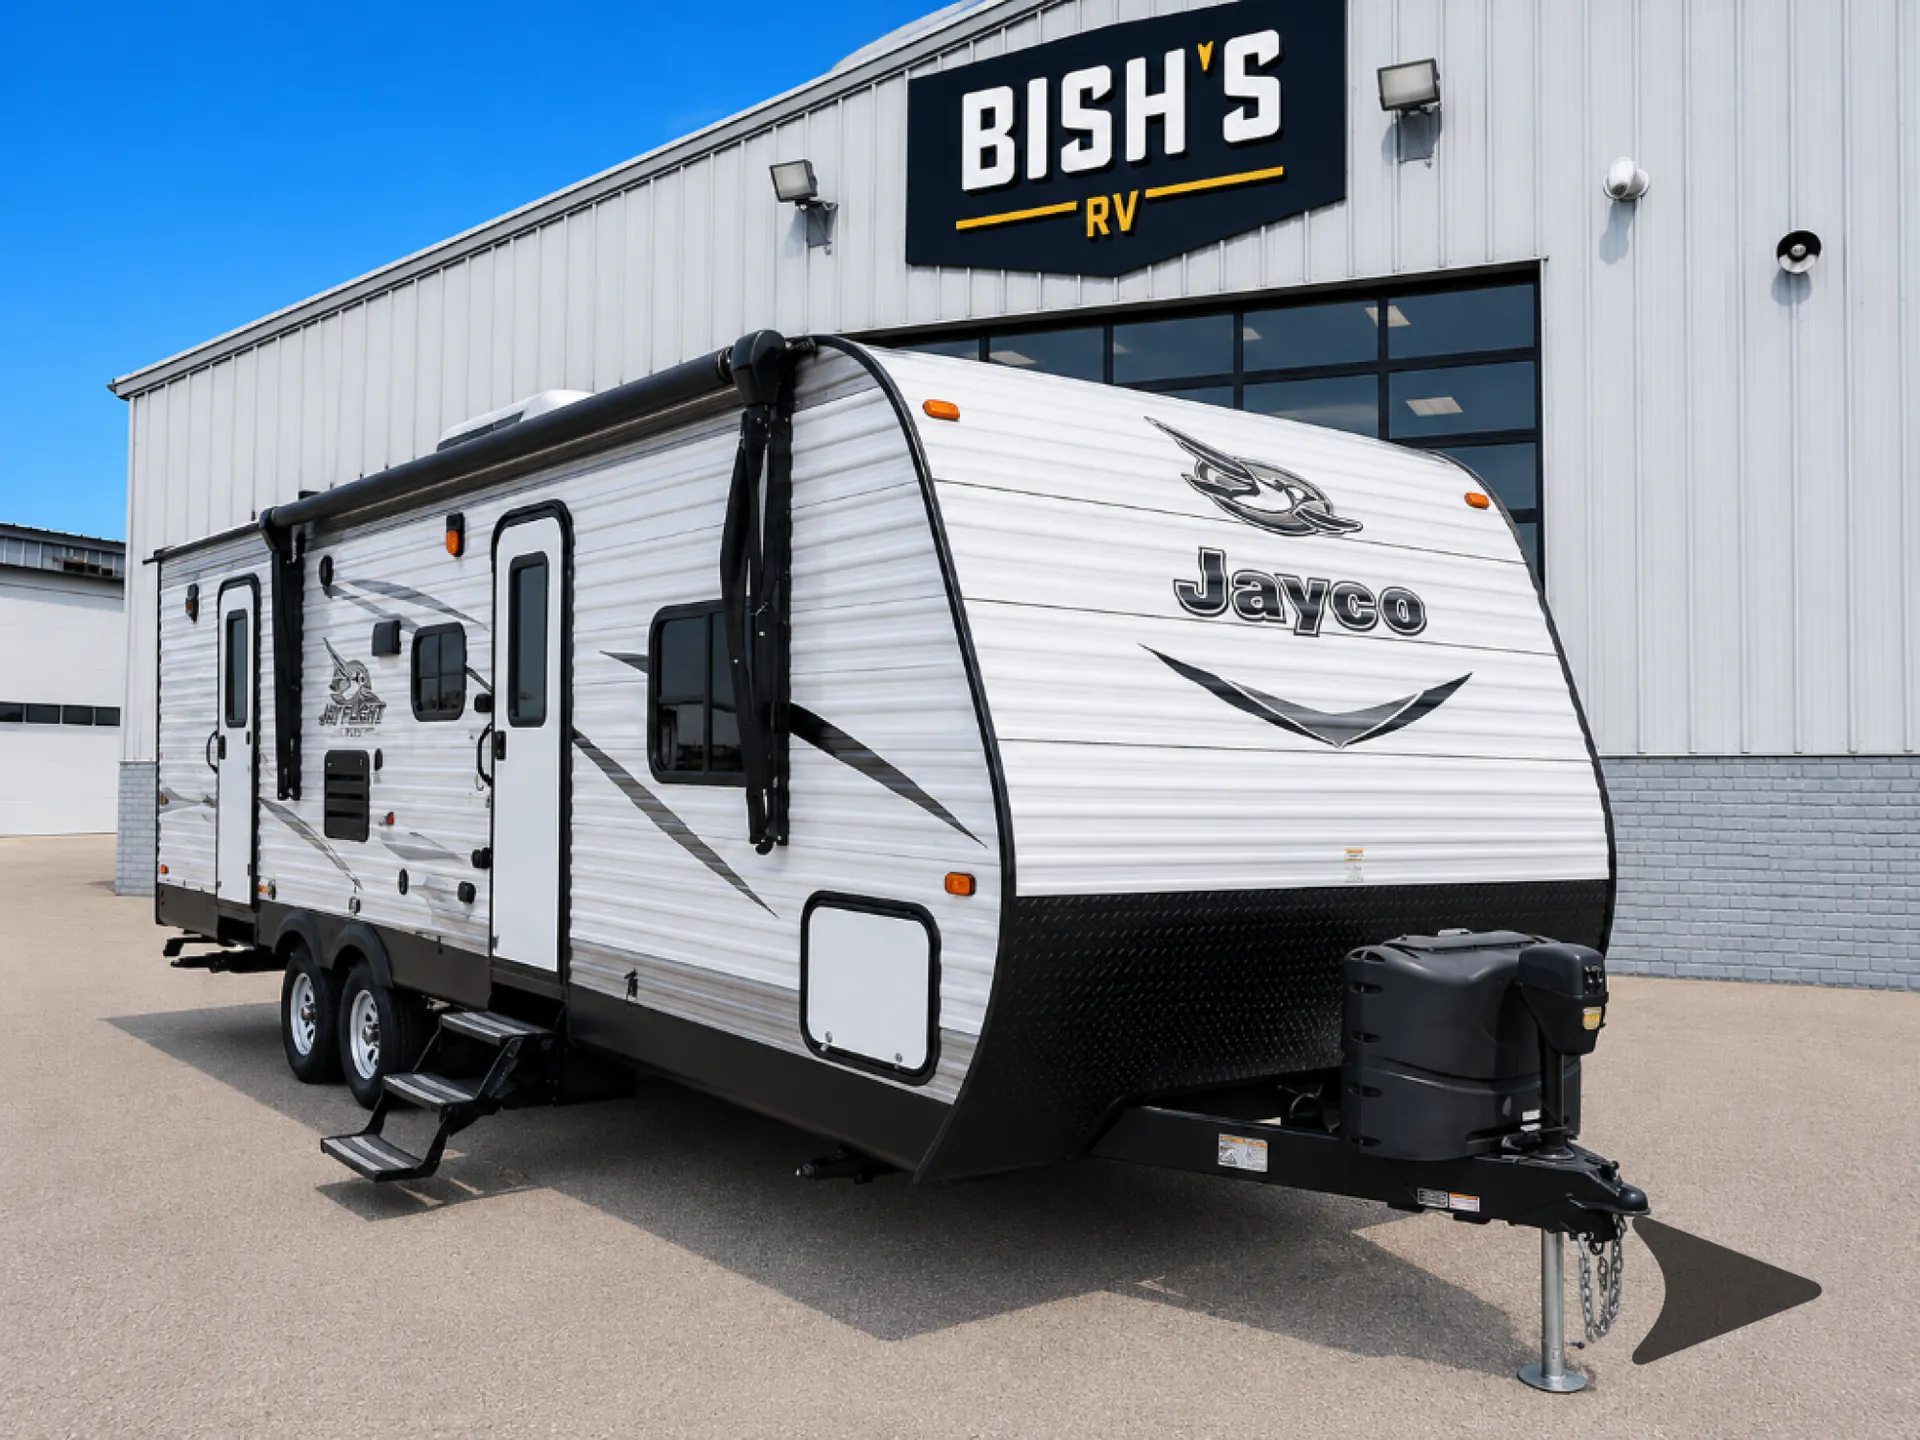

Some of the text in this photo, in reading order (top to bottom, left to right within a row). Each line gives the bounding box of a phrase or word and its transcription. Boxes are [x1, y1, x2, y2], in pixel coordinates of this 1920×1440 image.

[962, 29, 1282, 191] BISH'S
[1086, 190, 1139, 238] RV
[1173, 546, 1428, 638] Jayco
